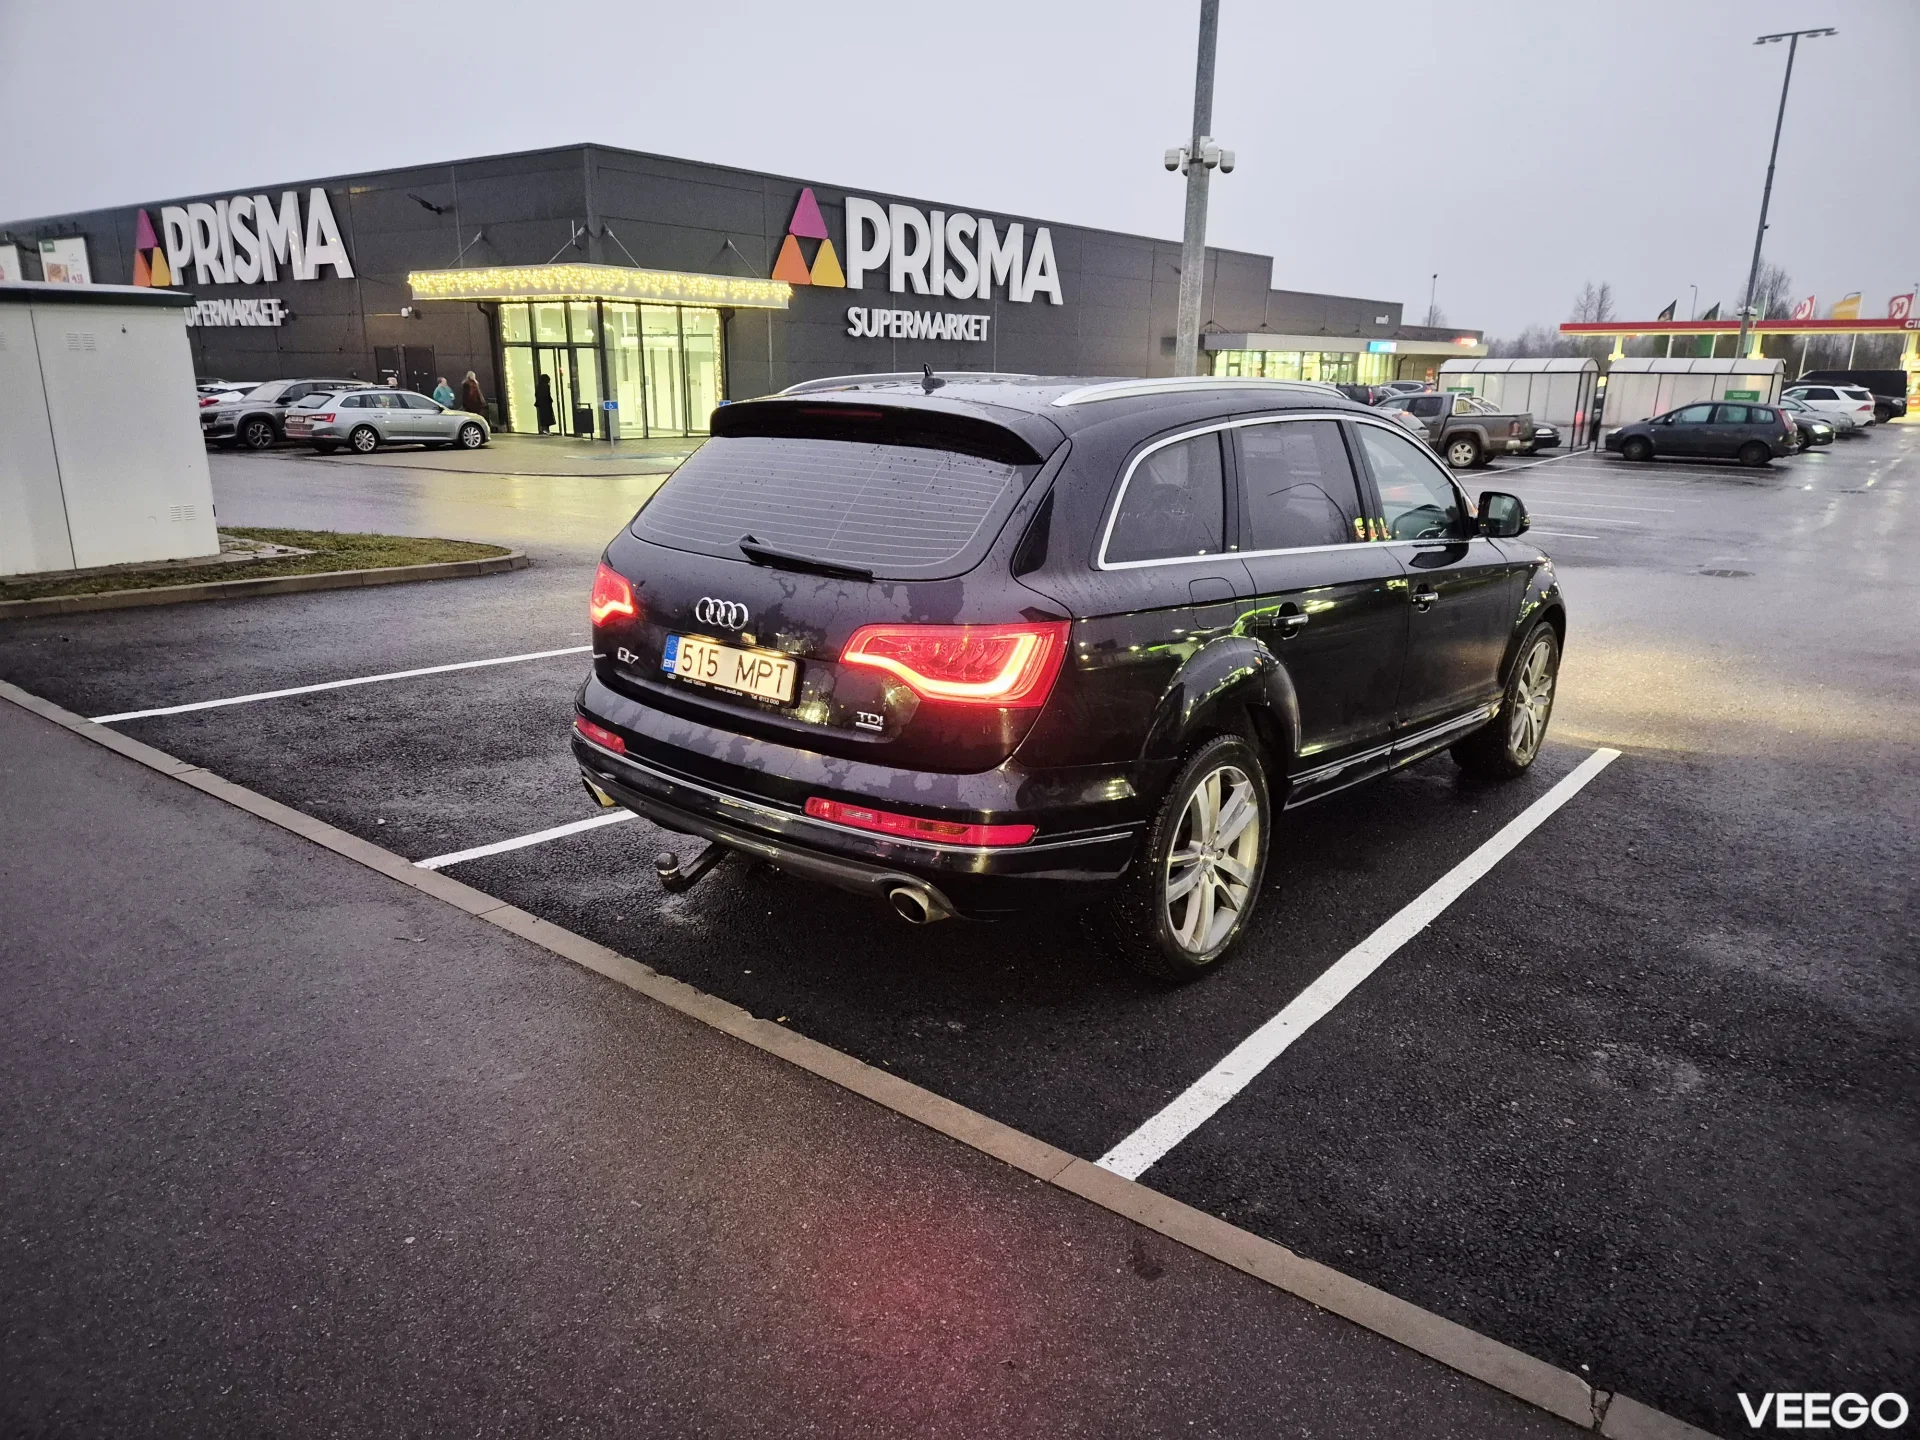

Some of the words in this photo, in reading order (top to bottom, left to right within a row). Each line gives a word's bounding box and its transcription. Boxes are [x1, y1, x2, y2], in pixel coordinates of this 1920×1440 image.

[161, 187, 355, 286] PRISMA
[845, 196, 1064, 306] PRISMA
[183, 298, 282, 327] UPERMARKET
[847, 306, 990, 342] SUPERMARKET
[1904, 319, 1920, 329] CI
[617, 646, 639, 665] Q7
[663, 659, 676, 669] EST
[682, 643, 719, 677] 515
[735, 654, 789, 694] MPT
[856, 711, 884, 726] TDI
